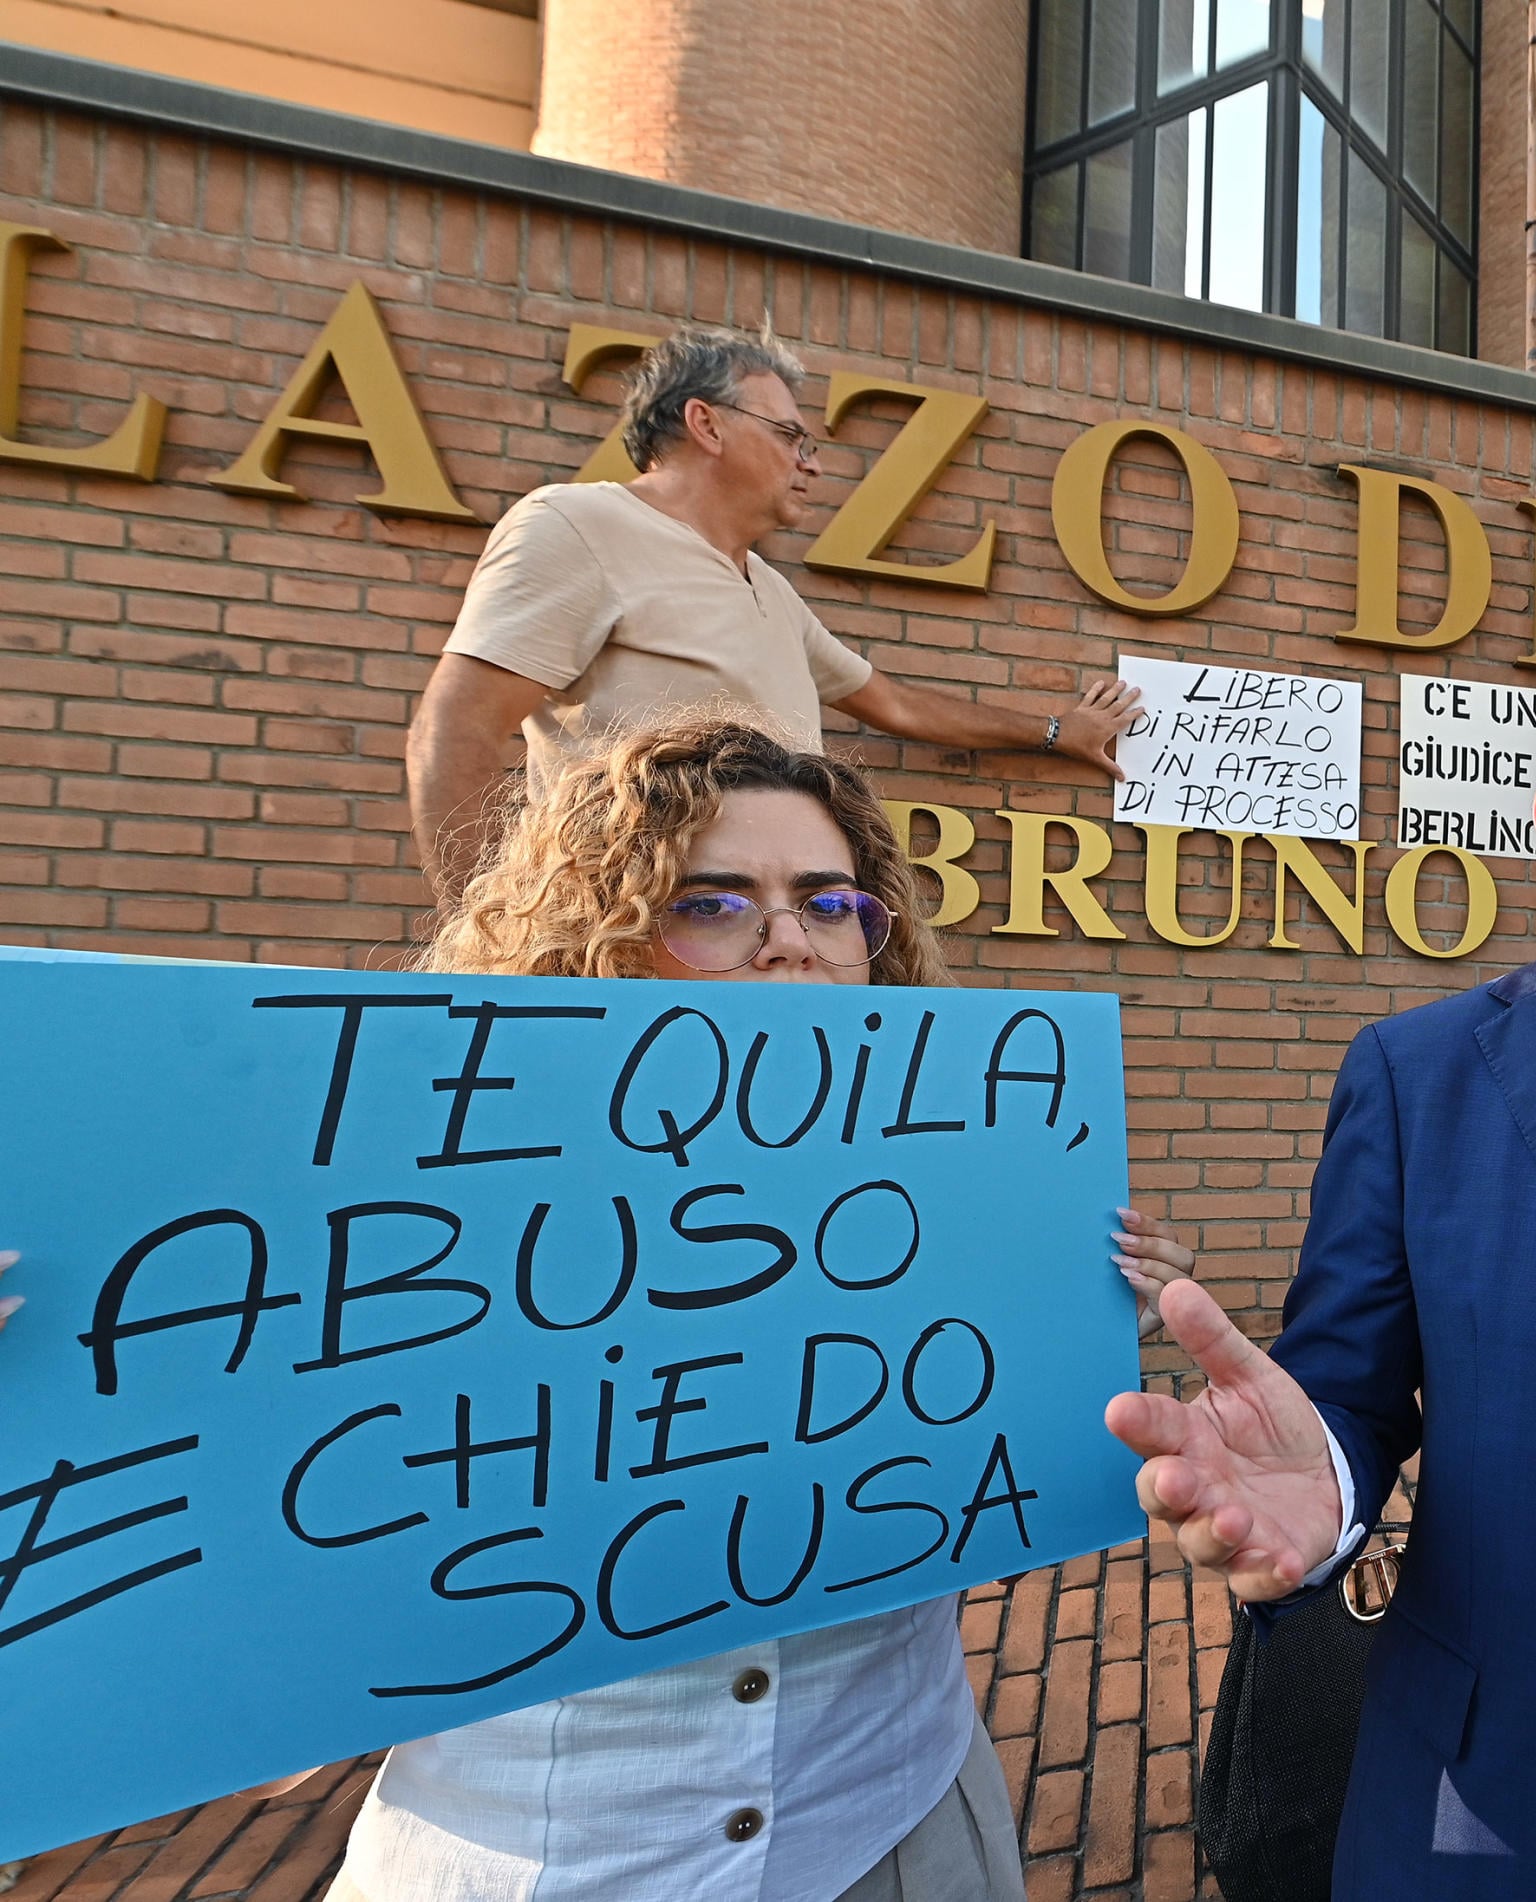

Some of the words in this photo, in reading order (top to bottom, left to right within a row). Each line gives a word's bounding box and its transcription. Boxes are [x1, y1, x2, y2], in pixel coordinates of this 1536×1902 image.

[1174, 784, 1357, 835] PROCESSO
[1215, 752, 1349, 791] ATTESA
[884, 799, 1498, 958] BRUNO
[77, 1179, 920, 1396] ABUSO
[368, 1432, 1039, 1698] SCUSA
